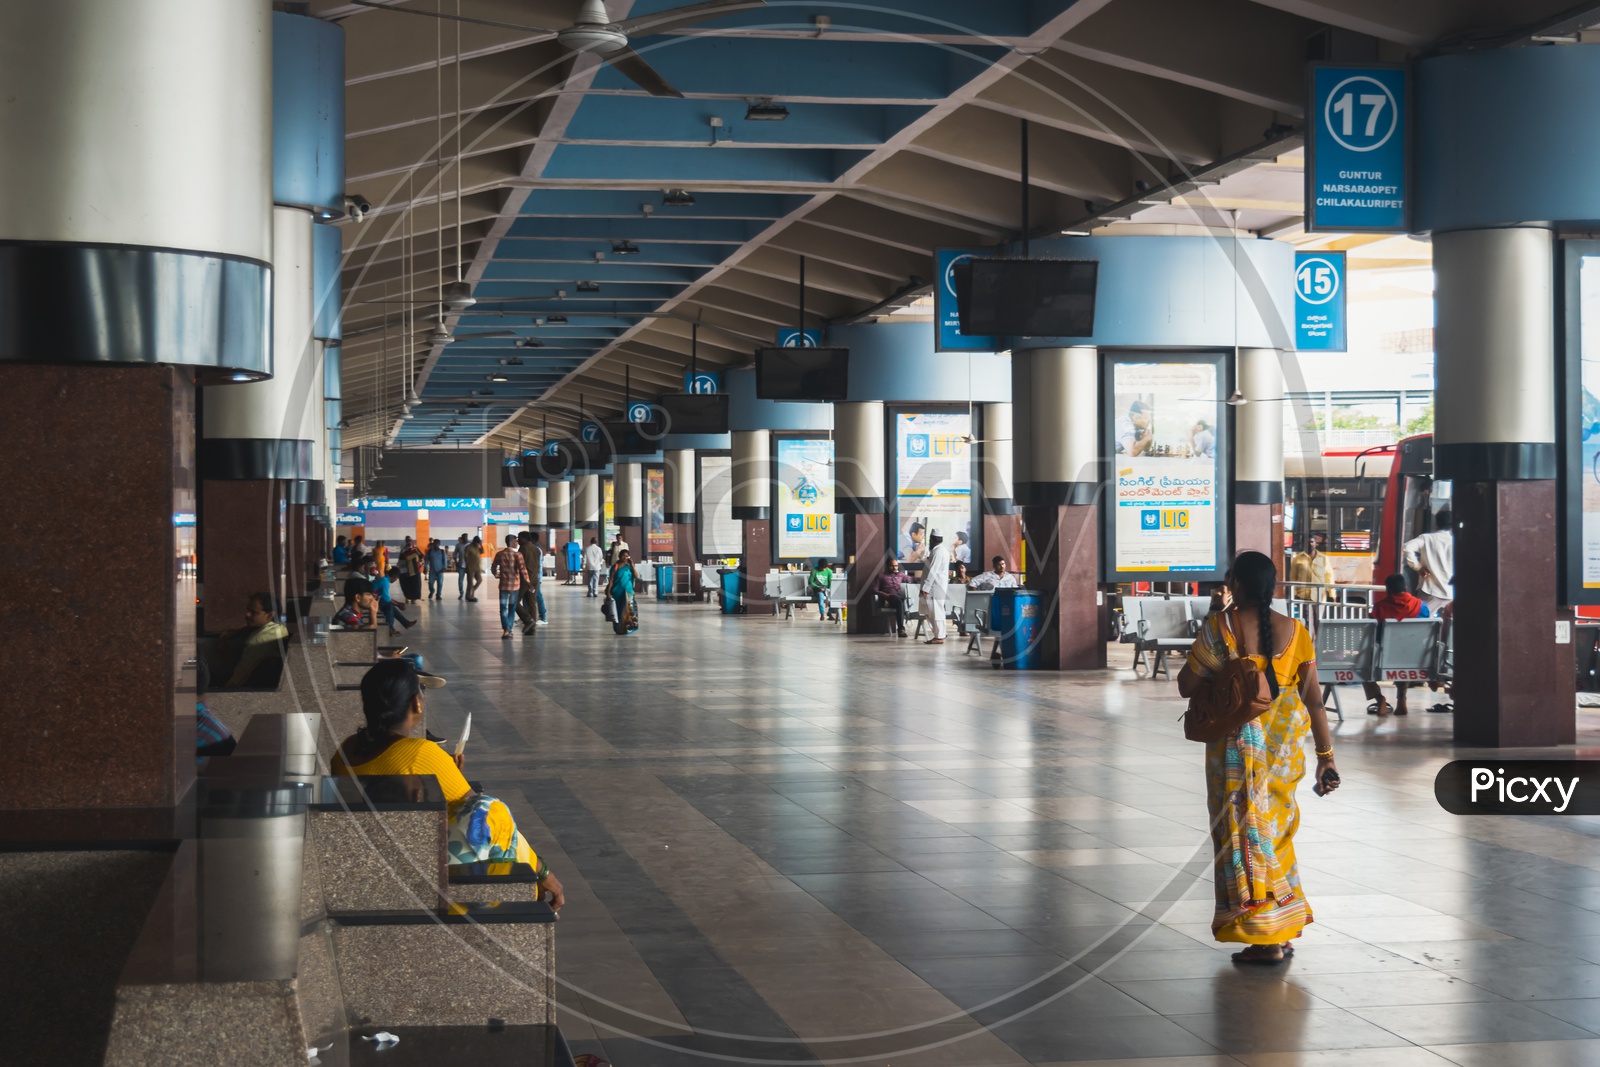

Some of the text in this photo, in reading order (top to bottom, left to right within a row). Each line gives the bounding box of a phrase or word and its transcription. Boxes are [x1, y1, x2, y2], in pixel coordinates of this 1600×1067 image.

[1333, 93, 1387, 137] 17
[1338, 170, 1382, 180] GUNTUR
[1322, 184, 1398, 195] NARSARAOPET
[1316, 198, 1404, 209] CHILAKALURIPET
[1298, 267, 1332, 295] 15
[694, 381, 711, 394] 11
[634, 408, 646, 423] 9
[587, 428, 597, 442] 7
[934, 436, 962, 455] LIC
[807, 515, 828, 531] LIC
[1163, 511, 1187, 528] LIC
[1334, 670, 1428, 681] 120 MGBS
